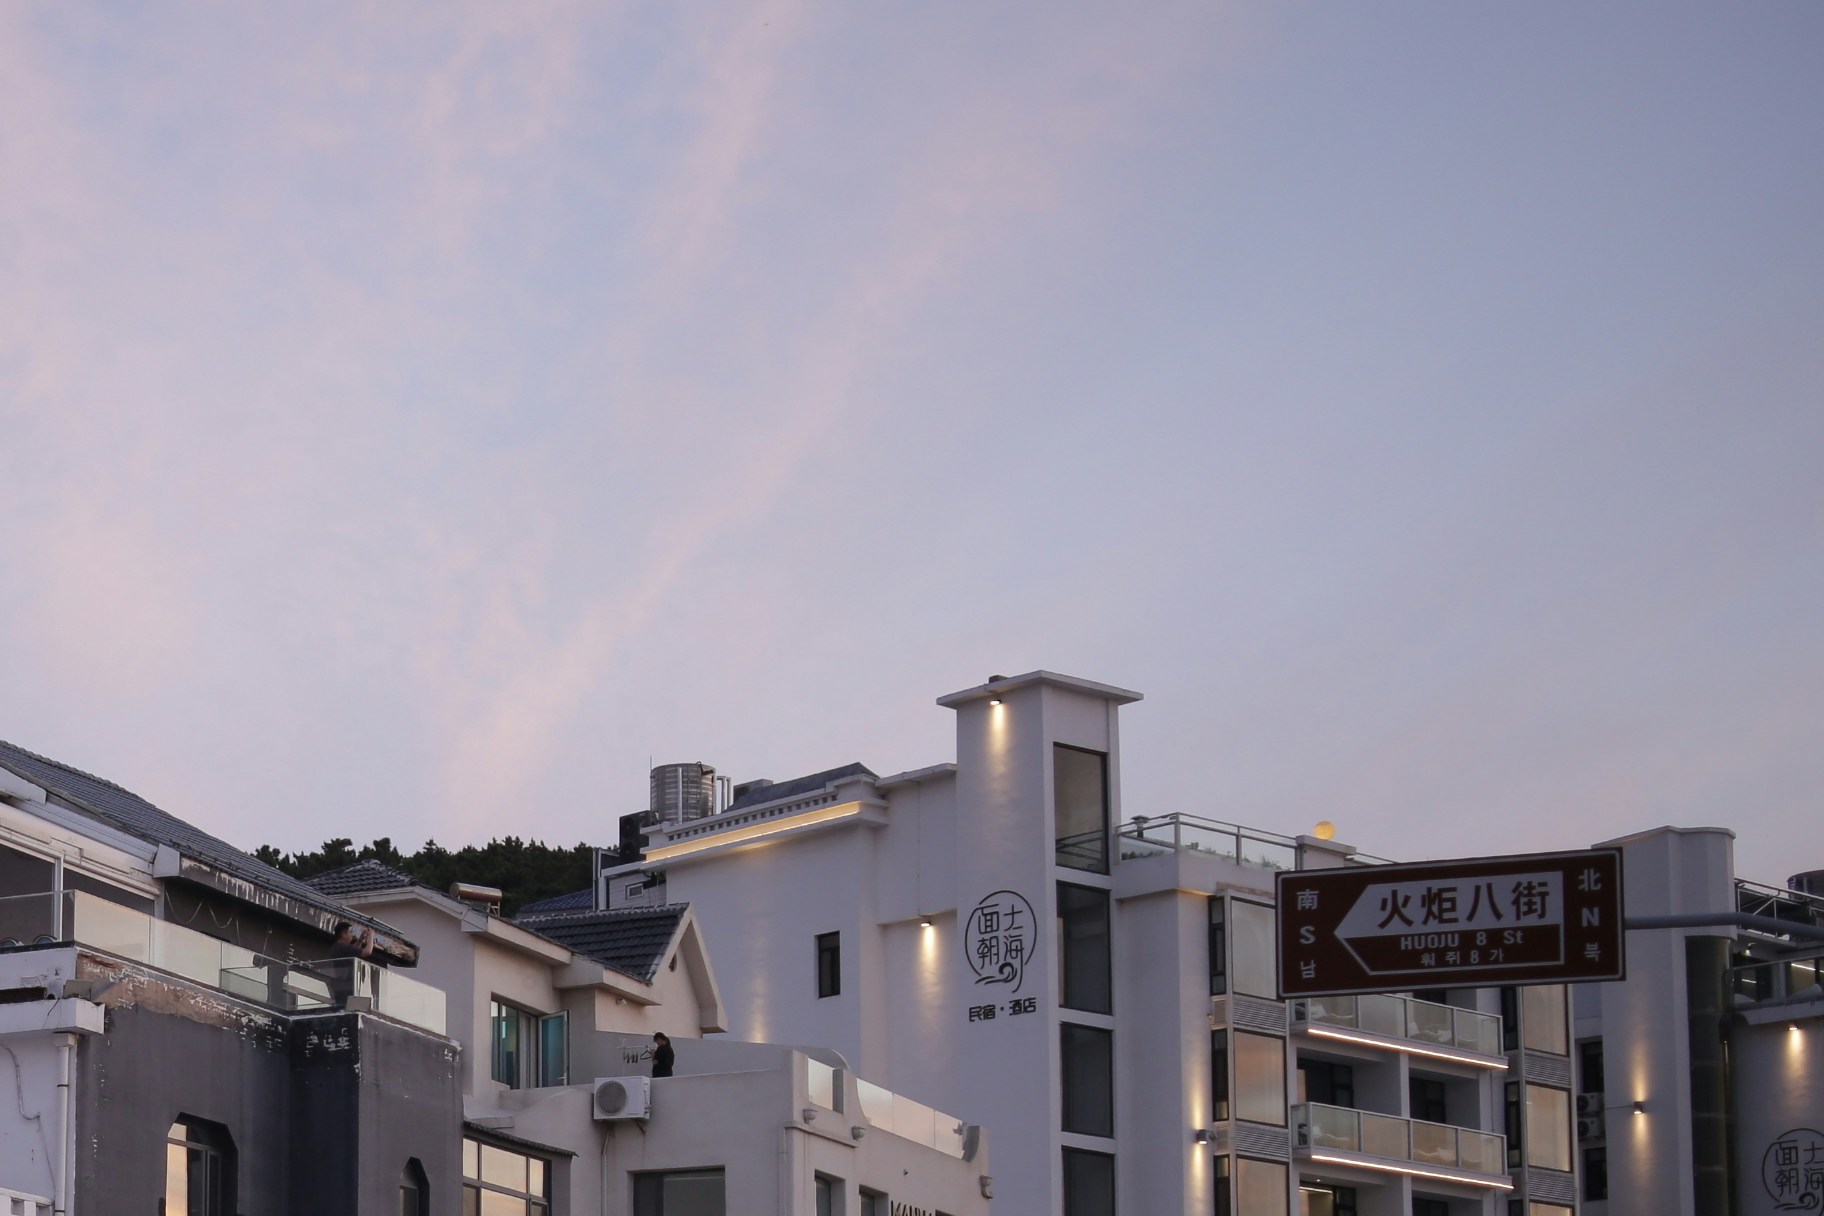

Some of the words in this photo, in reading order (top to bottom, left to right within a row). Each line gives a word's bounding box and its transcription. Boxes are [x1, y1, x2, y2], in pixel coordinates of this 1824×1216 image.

[1579, 868, 1601, 892] 北
[1296, 888, 1320, 911] 南
[1377, 880, 1550, 929] 火炬八街
[1581, 906, 1600, 928] N
[1299, 925, 1316, 945] S
[1400, 933, 1459, 950] HUOJU
[1476, 932, 1487, 946] 8
[1503, 929, 1523, 945] St
[1584, 943, 1601, 962] 북
[1299, 960, 1317, 979] 남
[968, 997, 1037, 1022] 民宿·酒店
